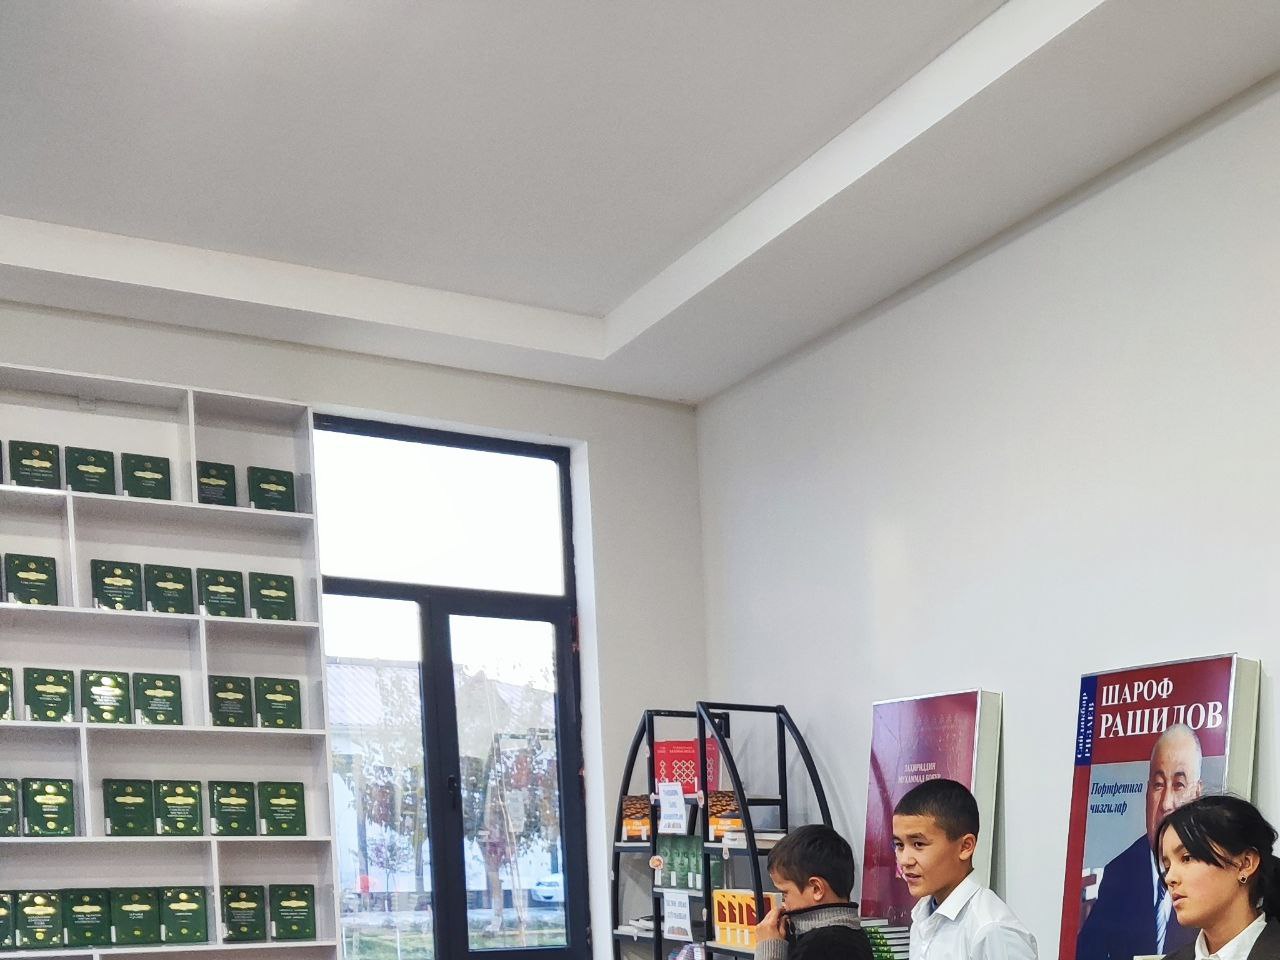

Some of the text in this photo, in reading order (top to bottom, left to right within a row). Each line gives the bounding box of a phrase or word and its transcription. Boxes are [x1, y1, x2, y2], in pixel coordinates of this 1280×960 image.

[1101, 677, 1174, 707] ШАРОФ
[1099, 701, 1224, 739] РАШИДОВ
[1091, 781, 1144, 797] Портретига
[1090, 801, 1128, 815] чизгилар
